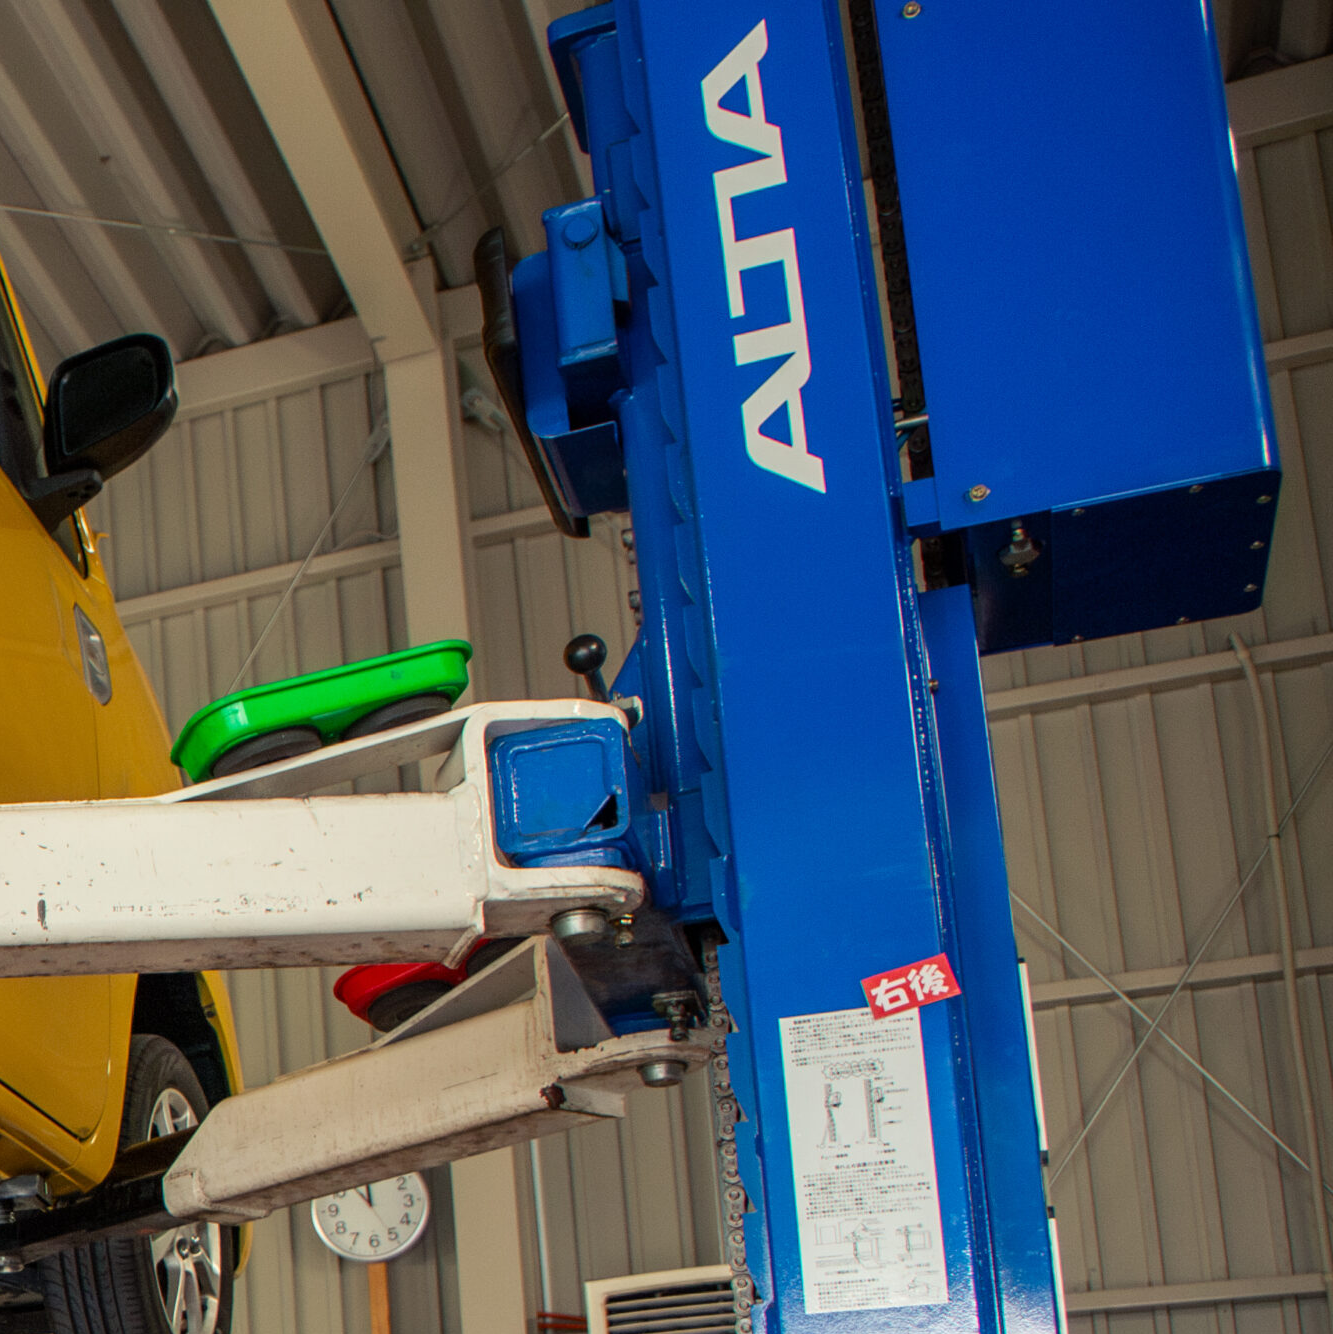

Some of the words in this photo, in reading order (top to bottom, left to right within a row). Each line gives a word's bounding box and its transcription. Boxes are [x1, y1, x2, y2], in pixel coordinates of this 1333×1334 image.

[700, 18, 827, 494] ALTIA
[870, 964, 949, 1012] 右後
[396, 1176, 408, 1191] 2
[403, 1194, 414, 1207] 3
[328, 1203, 339, 1217] 9
[399, 1212, 411, 1225] 4
[335, 1221, 346, 1234] 8
[387, 1227, 398, 1241] 5
[350, 1231, 360, 1245] 7
[369, 1234, 380, 1248] 6
